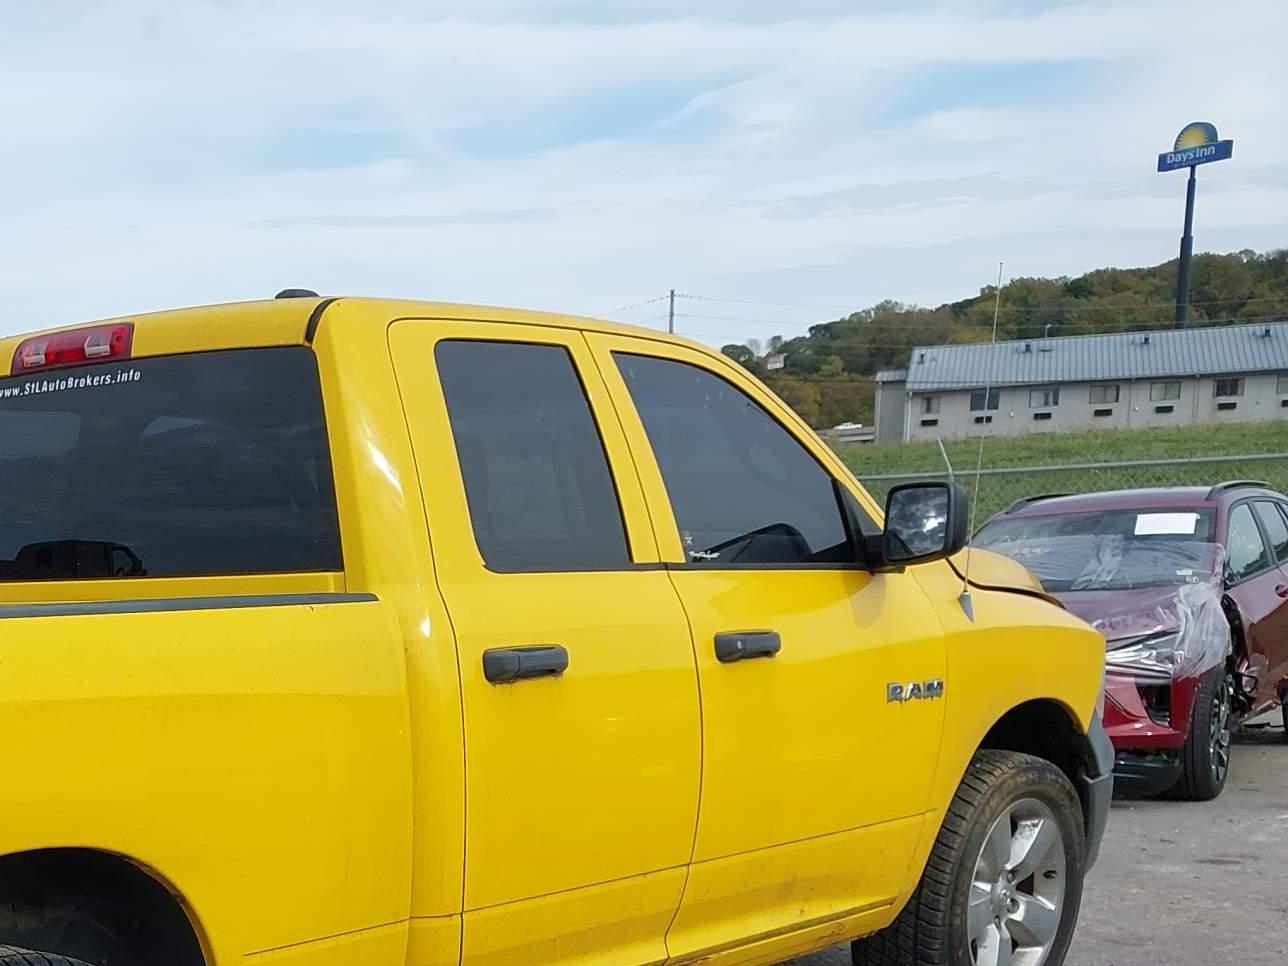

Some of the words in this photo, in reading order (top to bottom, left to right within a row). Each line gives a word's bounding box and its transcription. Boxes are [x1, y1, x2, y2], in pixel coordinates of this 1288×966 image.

[1167, 149, 1195, 164] Days
[1196, 145, 1216, 158] Inn
[886, 680, 945, 702] RAM
